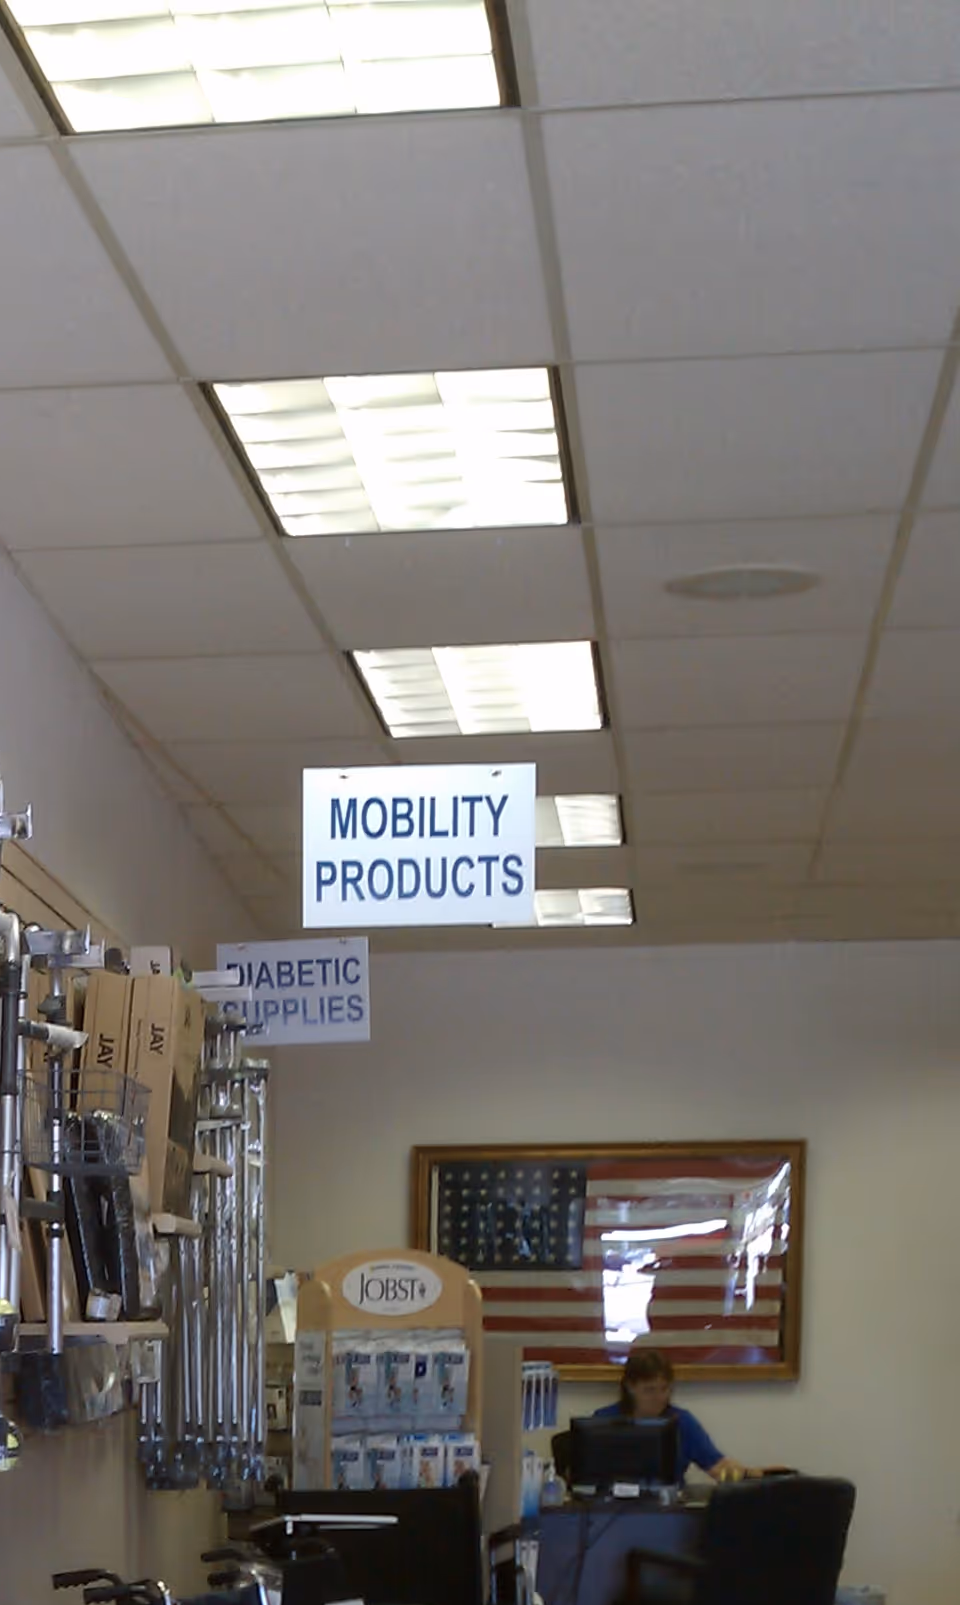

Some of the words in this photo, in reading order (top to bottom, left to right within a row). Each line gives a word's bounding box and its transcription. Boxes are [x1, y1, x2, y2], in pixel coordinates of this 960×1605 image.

[330, 795, 509, 840] MOBILITY
[315, 855, 524, 902] PRODUCTS
[97, 1033, 115, 1068] JAY
[150, 1023, 165, 1055] JAY
[359, 1272, 419, 1305] JOBST
